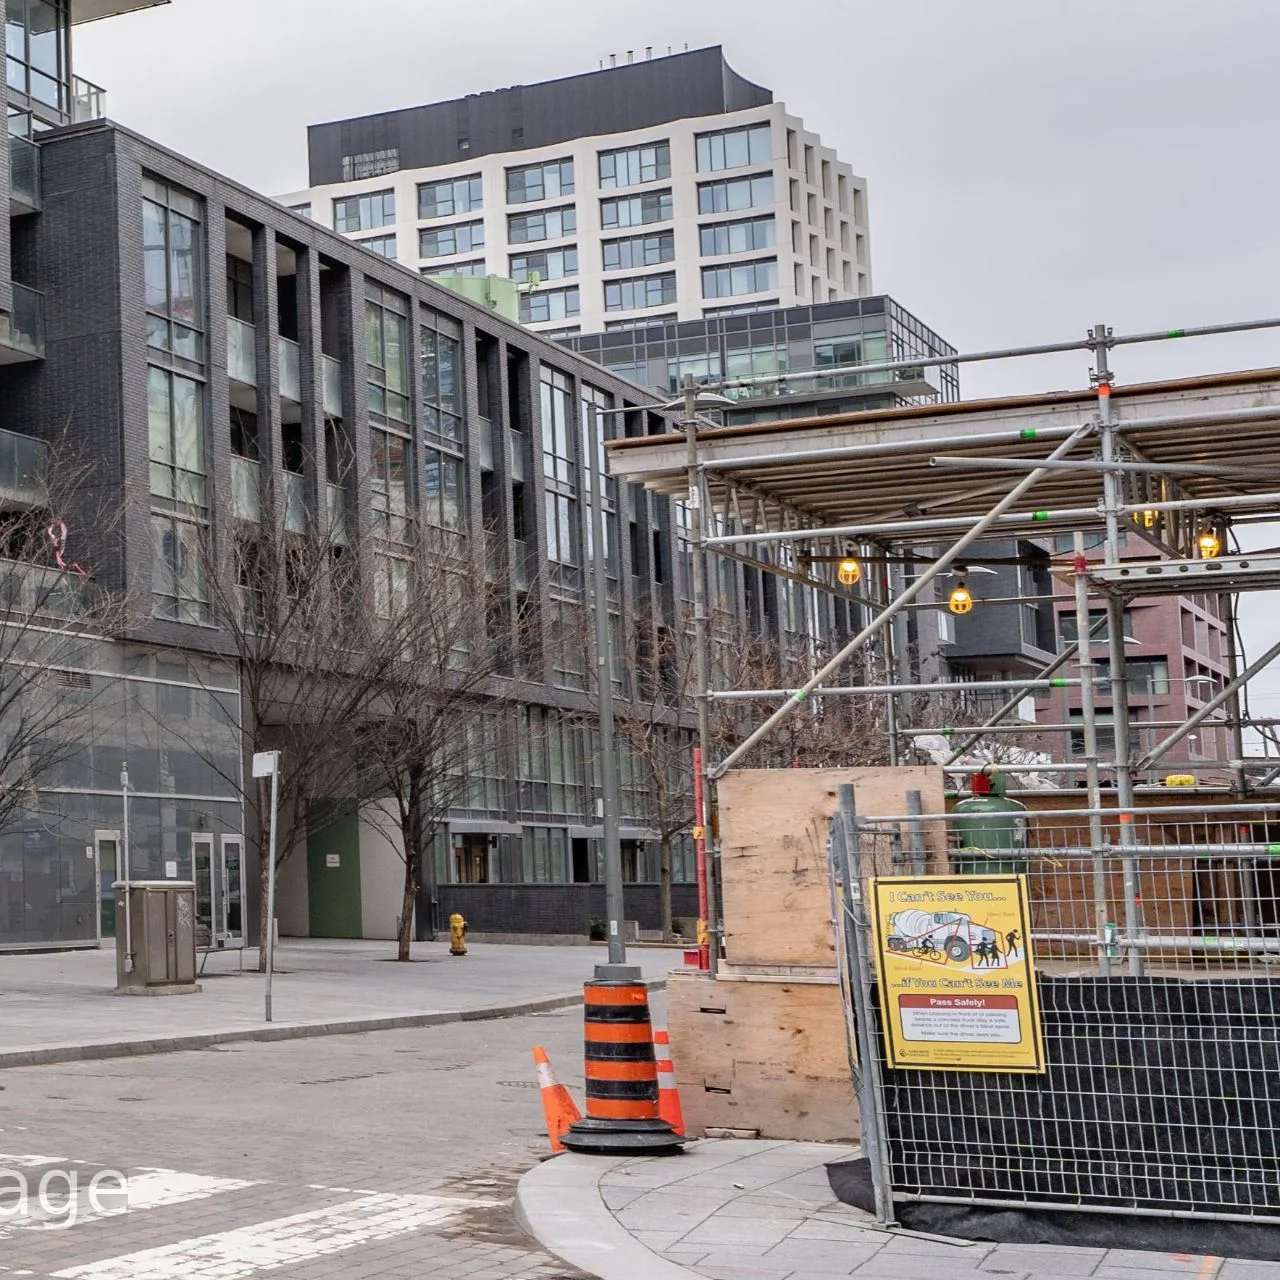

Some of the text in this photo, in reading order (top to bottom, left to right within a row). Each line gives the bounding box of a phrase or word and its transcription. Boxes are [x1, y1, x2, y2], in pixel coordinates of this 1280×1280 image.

[889, 890, 1007, 902] I Can't See You...
[911, 978, 936, 988] You
[940, 977, 973, 988] Can't
[973, 978, 999, 989] See
[1001, 979, 1023, 989] Me
[930, 998, 985, 1008] Pass Safely!
